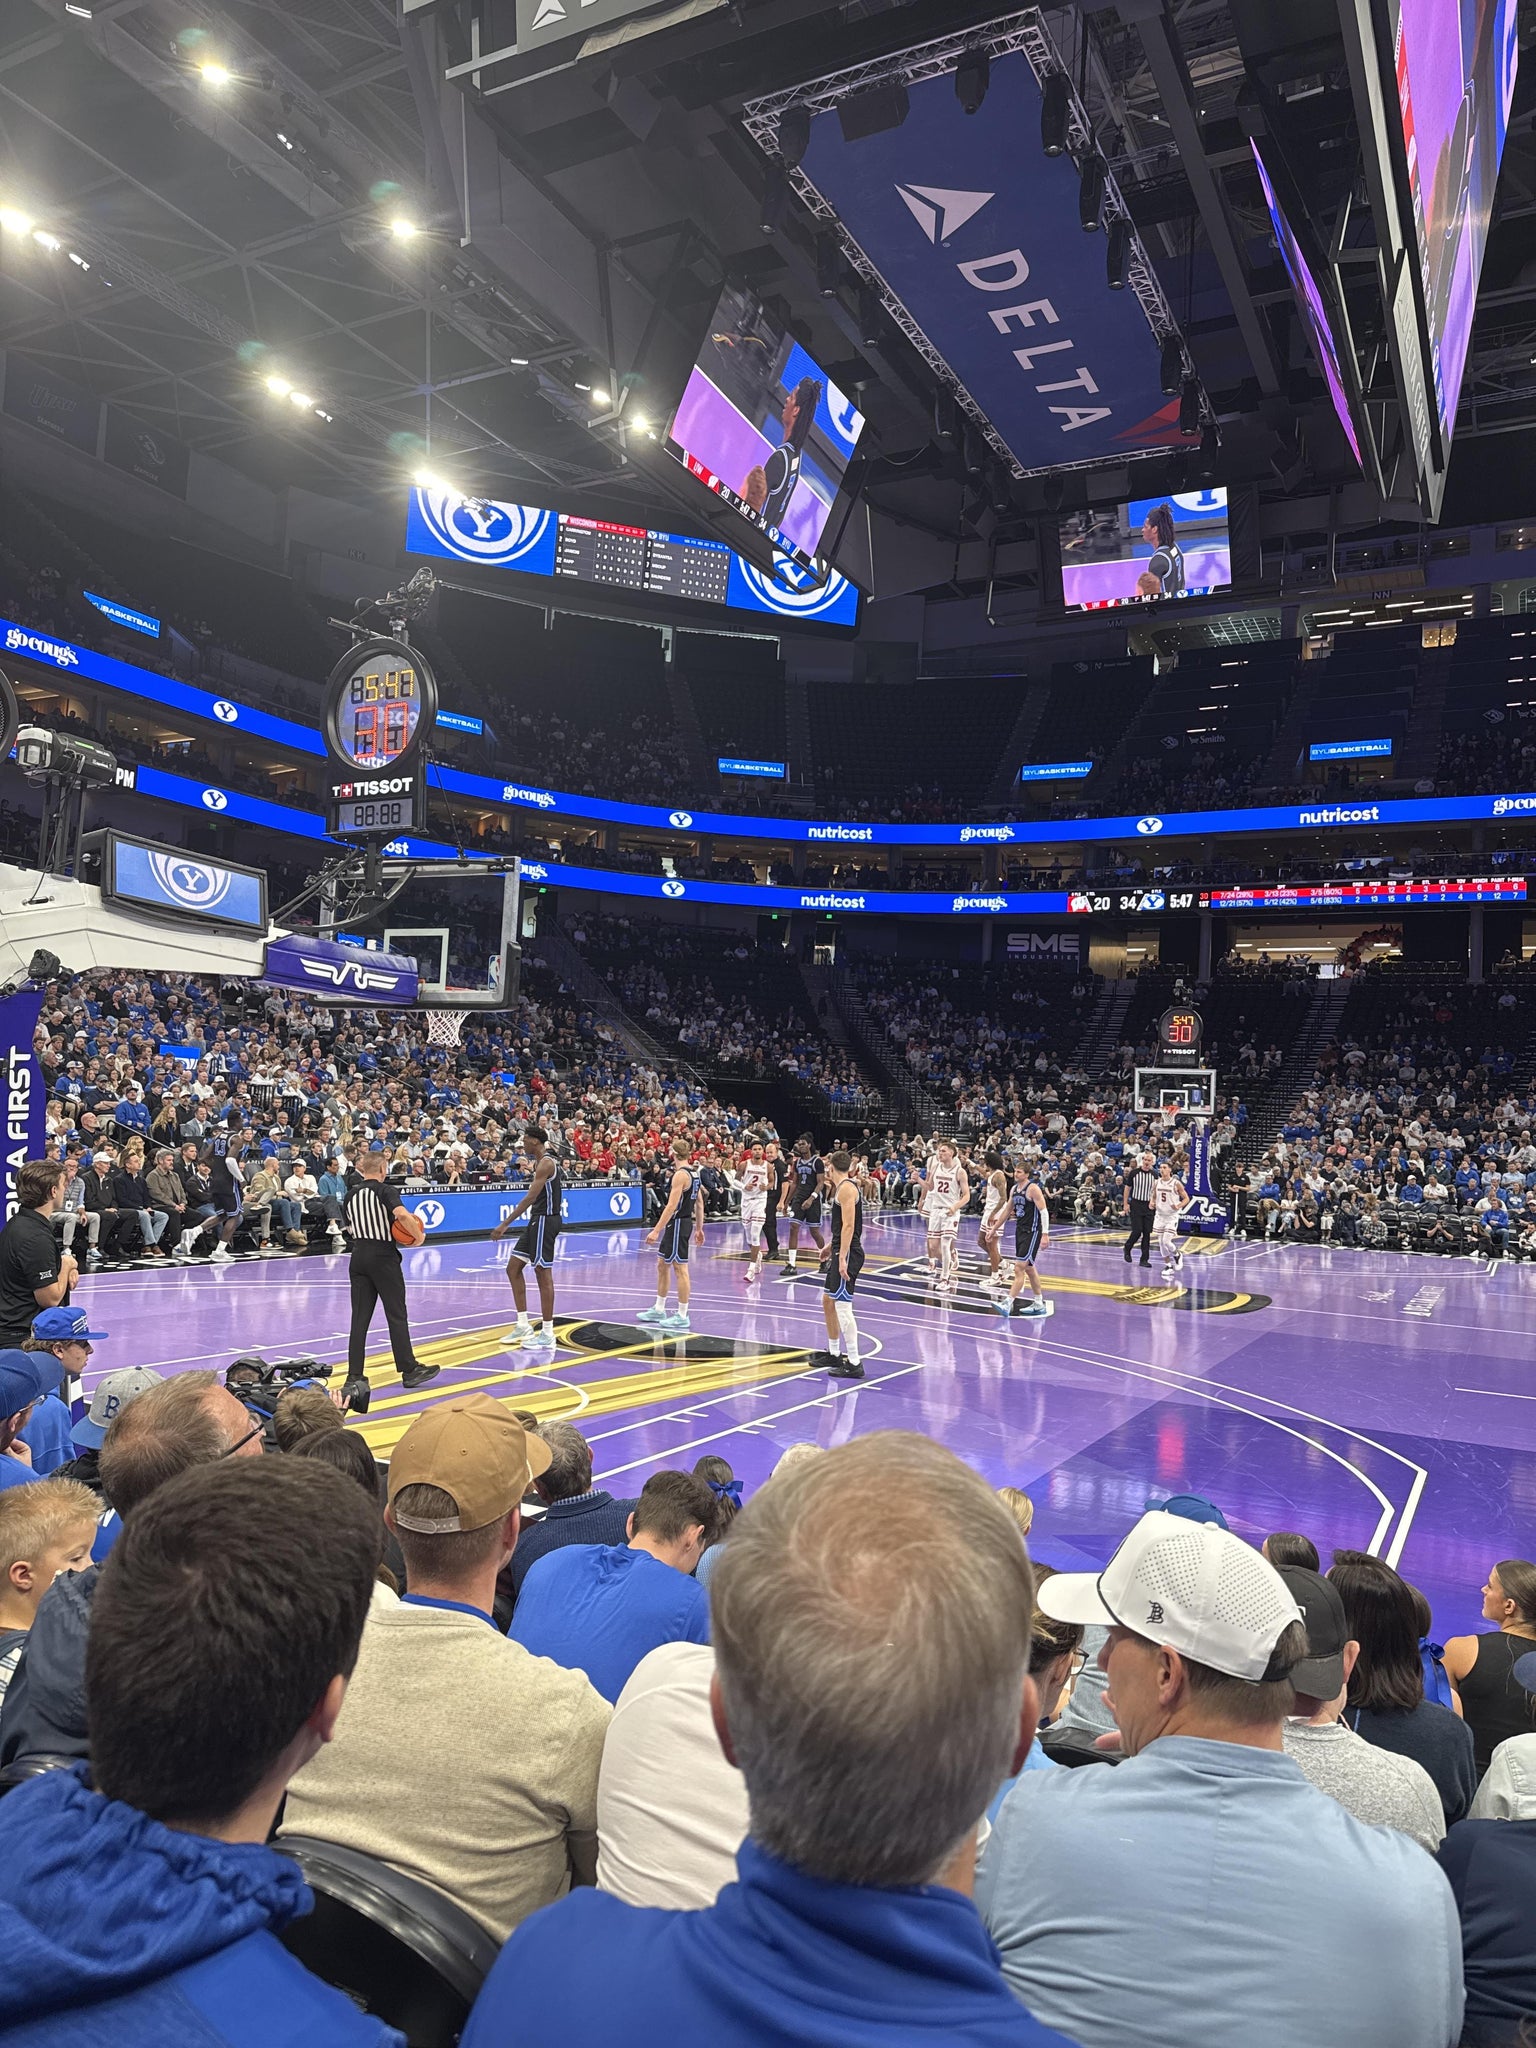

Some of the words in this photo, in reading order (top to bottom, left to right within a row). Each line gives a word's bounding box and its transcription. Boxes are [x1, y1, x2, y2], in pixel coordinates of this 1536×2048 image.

[956, 249, 1112, 432] DELTA
[721, 486, 730, 499] 20
[758, 518, 768, 531] 34
[658, 533, 670, 541] BYU
[1164, 591, 1172, 599] 34
[93, 602, 158, 631] BASKETBALL
[365, 669, 415, 702] 5:47
[436, 714, 481, 730] ASKETBALL
[116, 767, 135, 788] PM
[353, 777, 413, 797] TISSOT
[809, 825, 873, 840] nutricost
[1299, 806, 1380, 824] nutricost
[801, 893, 866, 909] nutricost
[1170, 894, 1193, 908] 5:47
[1200, 892, 1209, 900] 30
[1220, 891, 1236, 899] 7/24
[1311, 888, 1322, 896] 3/5
[1094, 897, 1111, 911] 20
[1120, 896, 1137, 910] 34
[1264, 898, 1278, 906] 5/12
[1007, 933, 1080, 953] SME
[1173, 1016, 1194, 1025] 5:47
[1168, 1025, 1192, 1042] 30
[7, 1045, 31, 1140] FIRST
[1195, 1138, 1203, 1159] FIRST
[752, 1175, 759, 1186] 2
[1194, 1160, 1202, 1192] AMERICA
[937, 1181, 949, 1193] 22
[1161, 1193, 1167, 1203] 5
[103, 1395, 120, 1419] B
